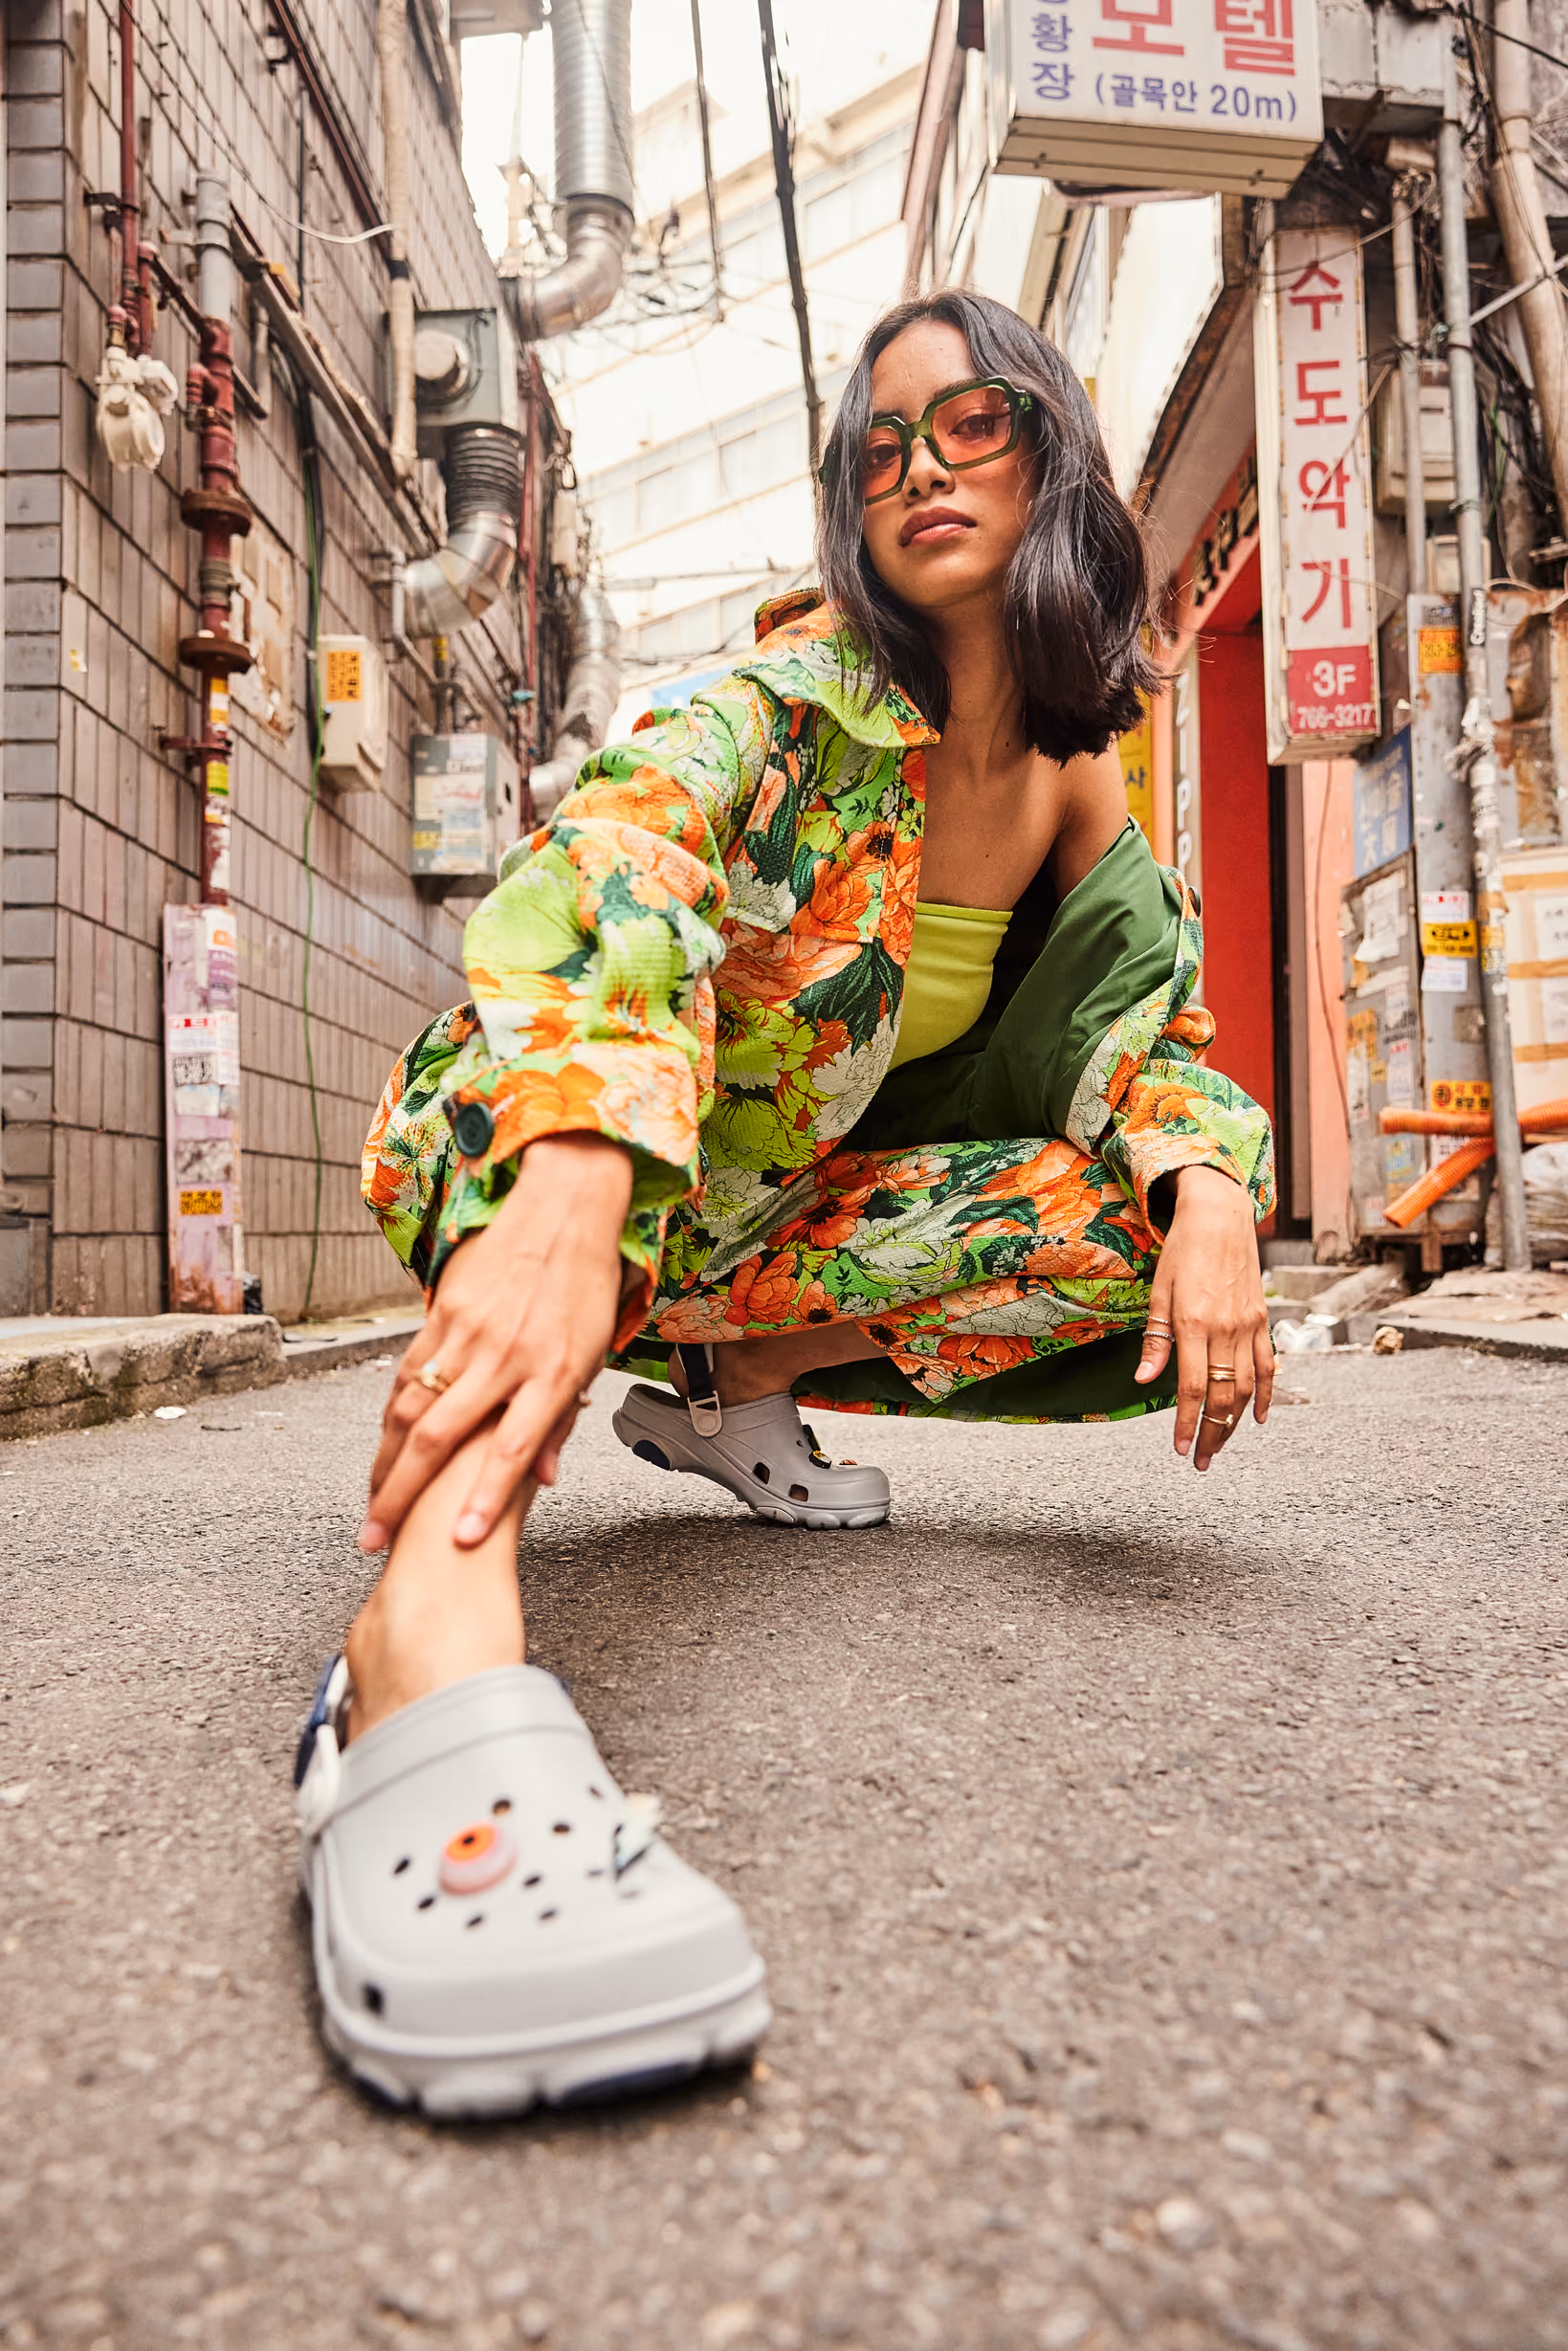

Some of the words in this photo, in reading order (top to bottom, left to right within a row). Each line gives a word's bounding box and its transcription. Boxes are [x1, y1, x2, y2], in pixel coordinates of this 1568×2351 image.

[1092, 0, 1295, 76] 모텔
[1096, 73, 1197, 112] (골목안
[1210, 84, 1296, 122] 20m)
[1312, 660, 1357, 697] 3F
